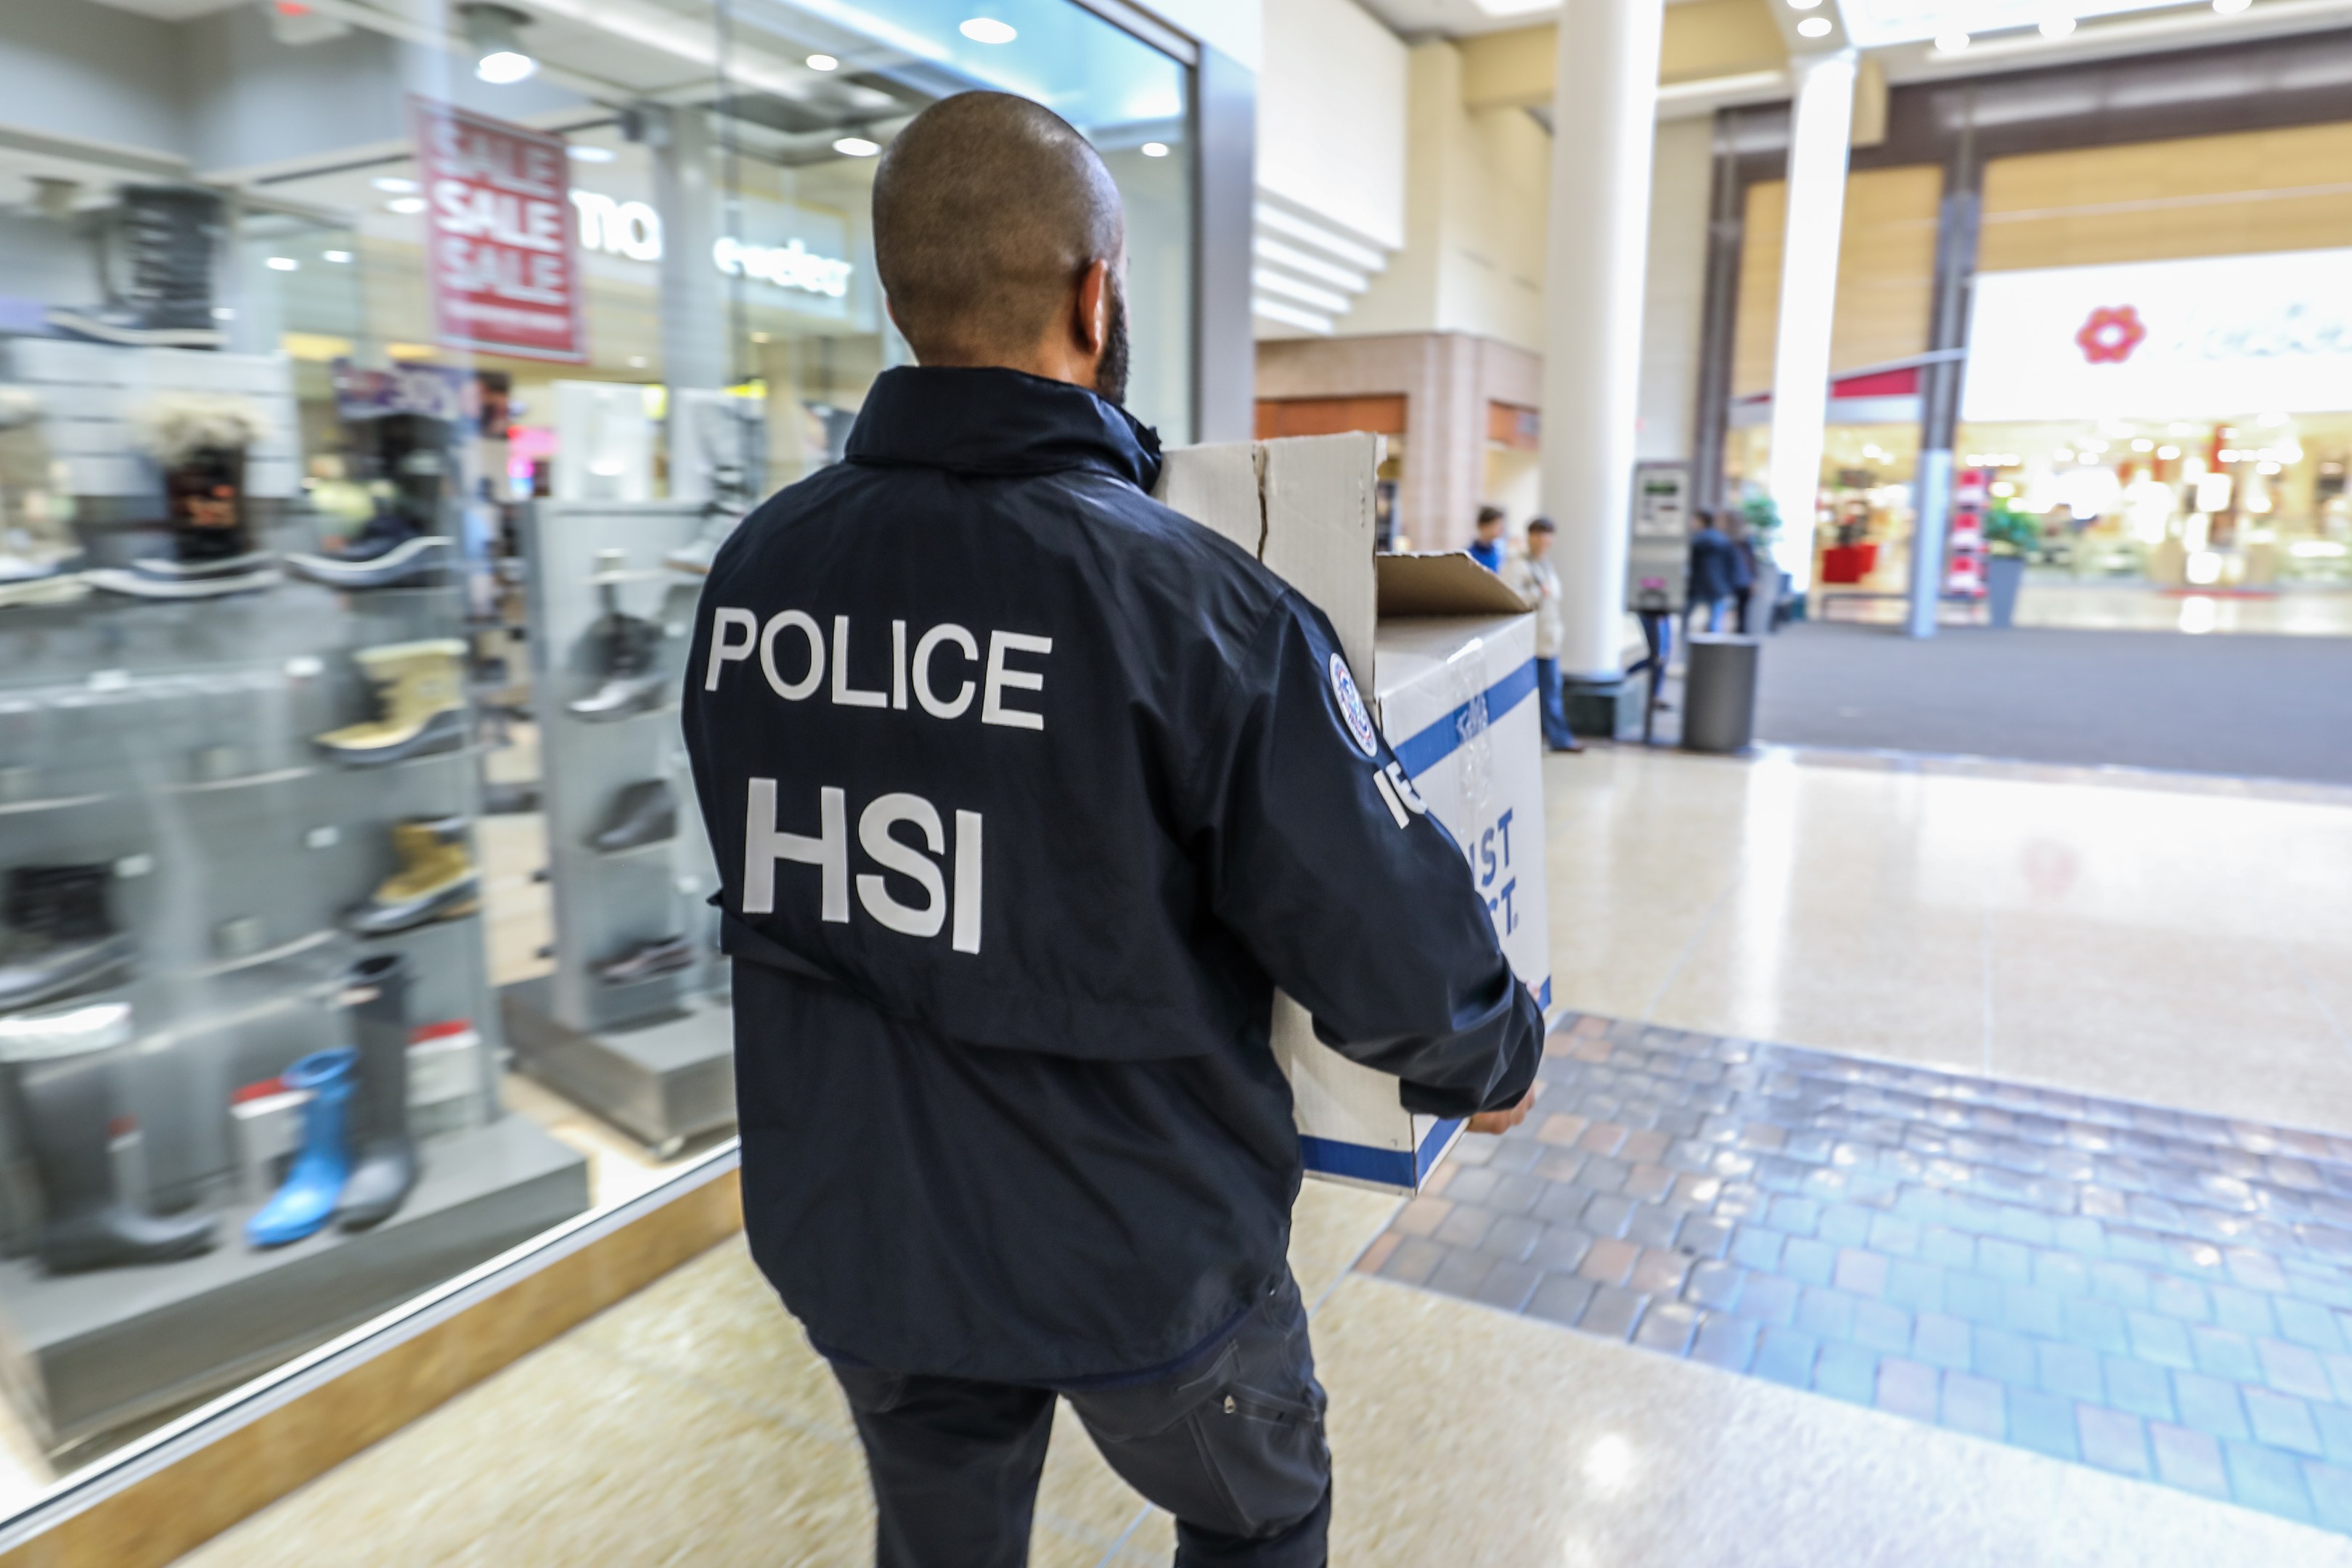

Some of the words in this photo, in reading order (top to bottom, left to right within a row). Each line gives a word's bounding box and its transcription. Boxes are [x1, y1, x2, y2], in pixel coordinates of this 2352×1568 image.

[432, 118, 558, 197] SALE
[434, 180, 563, 253] SALE
[438, 237, 566, 306] SALE
[705, 607, 1053, 730] POLICE
[743, 777, 982, 954] HSI
